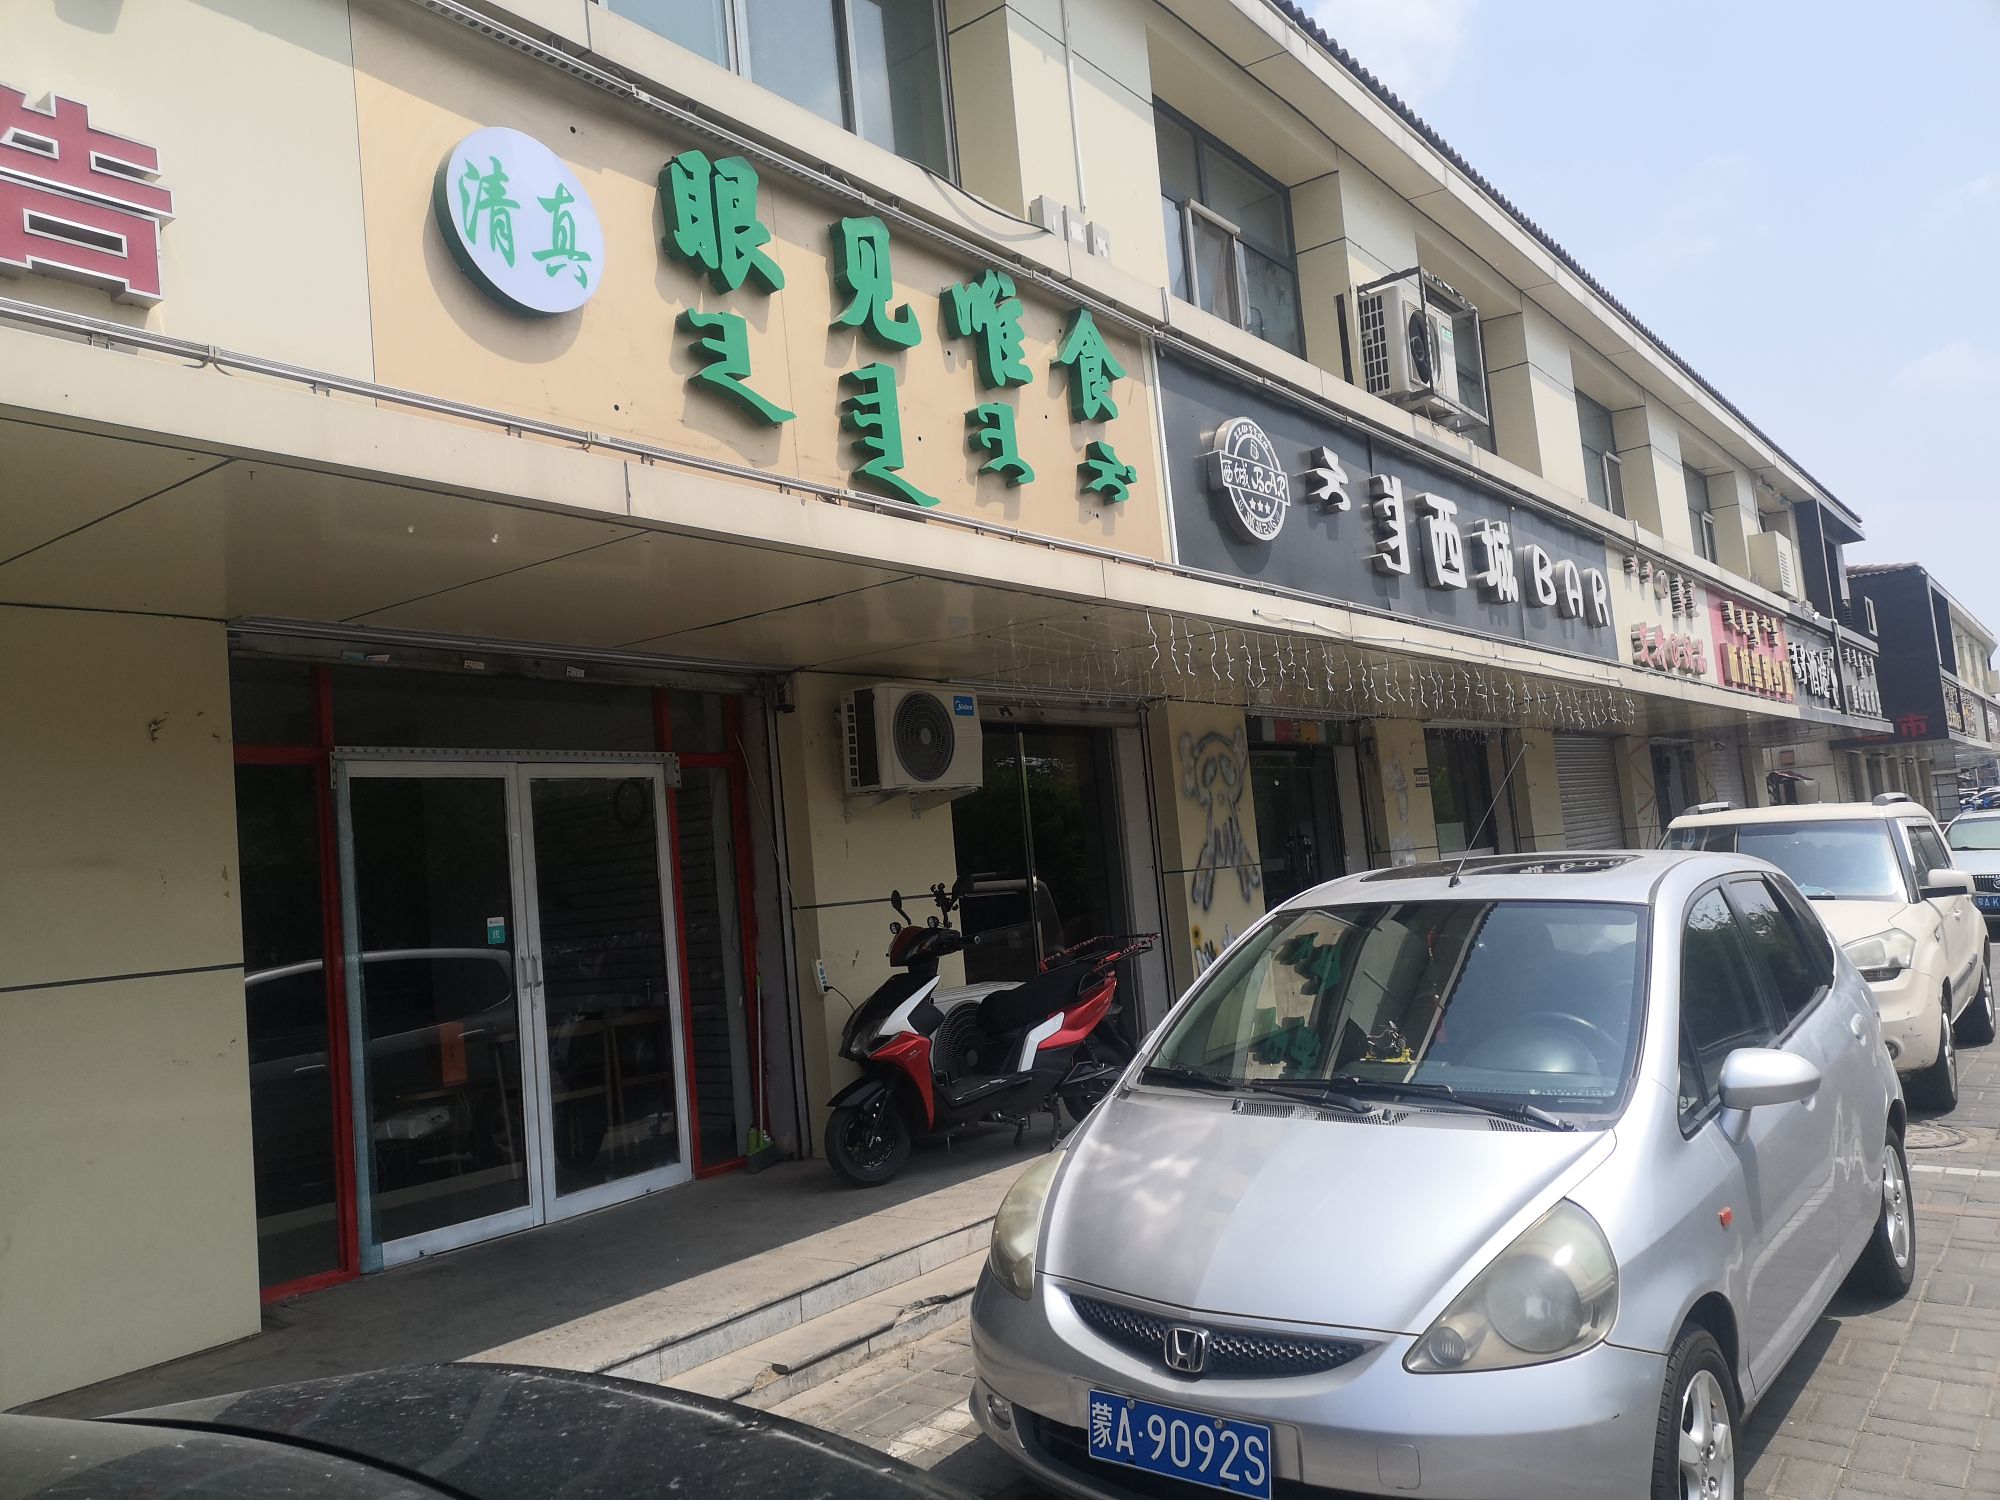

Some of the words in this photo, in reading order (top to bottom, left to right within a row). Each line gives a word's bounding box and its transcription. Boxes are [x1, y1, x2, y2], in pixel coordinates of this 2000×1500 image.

[0, 84, 175, 303] 告
[457, 155, 593, 290] 清真
[660, 149, 1127, 421] 眼见唯食
